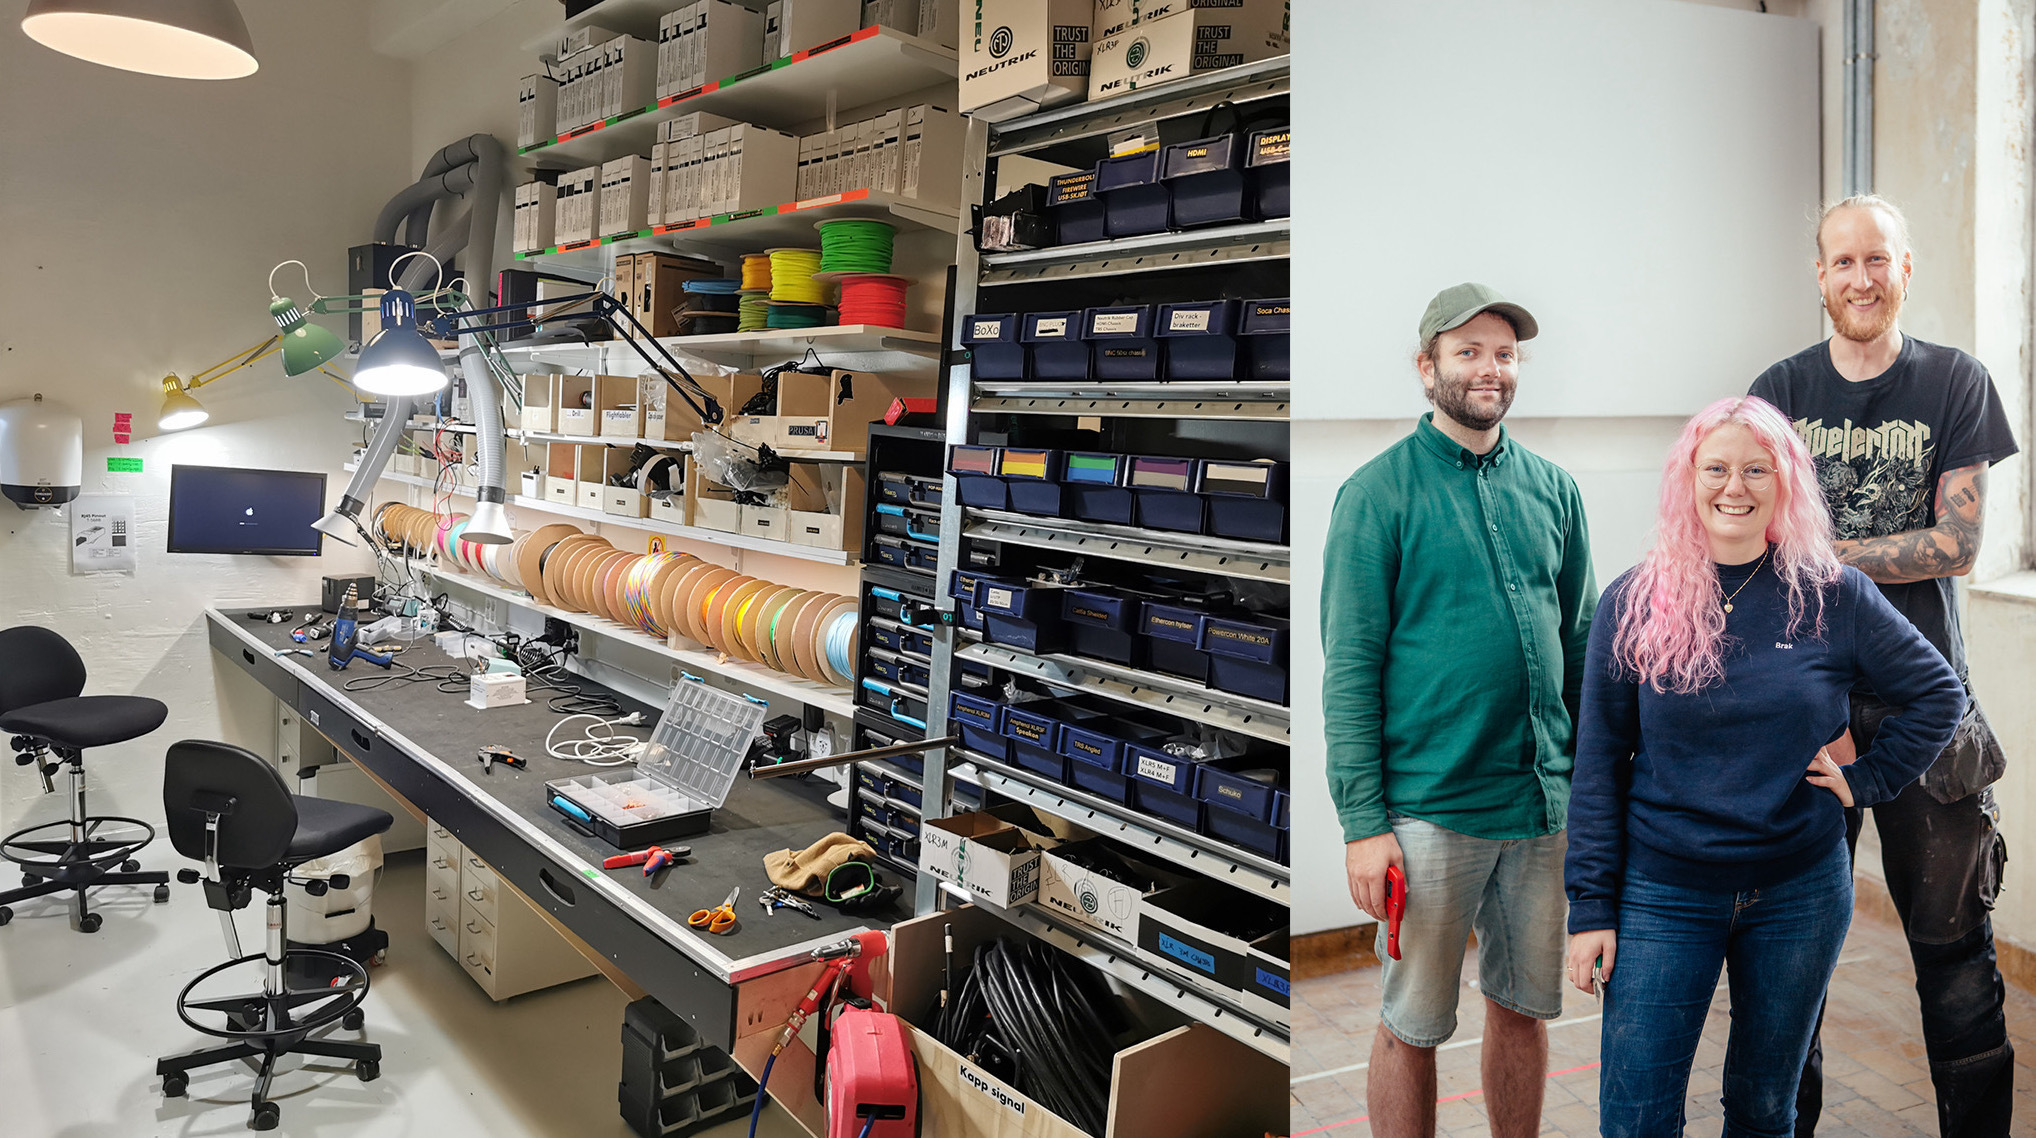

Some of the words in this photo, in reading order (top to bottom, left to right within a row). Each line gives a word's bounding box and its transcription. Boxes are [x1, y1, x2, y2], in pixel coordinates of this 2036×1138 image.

[1054, 27, 1088, 41] TRUST
[1198, 27, 1230, 38] TRUST
[1054, 45, 1075, 58] THE
[1197, 42, 1217, 53] THE
[965, 49, 1039, 82] NEUTRIK
[1194, 55, 1242, 69] ORIGINAL
[1187, 148, 1207, 157] HDMI
[1256, 306, 1273, 315] Soca
[1172, 321, 1201, 329] braketter
[788, 426, 814, 435] PRUSA
[1151, 616, 1175, 627] Ethercon
[1208, 627, 1237, 639] Powercon
[1238, 633, 1256, 642] White
[1256, 636, 1270, 645] 20A
[1016, 726, 1039, 739] Speakon
[1085, 744, 1101, 755] Angled
[1157, 764, 1170, 772] M+F
[1156, 772, 1169, 780] M+F
[1218, 786, 1242, 799] Schuko
[924, 831, 948, 849] XLR3M
[1012, 857, 1039, 879] TRUST
[1011, 874, 1029, 891] THE
[960, 1065, 989, 1092] Kapp
[991, 1087, 1025, 1114] signal
